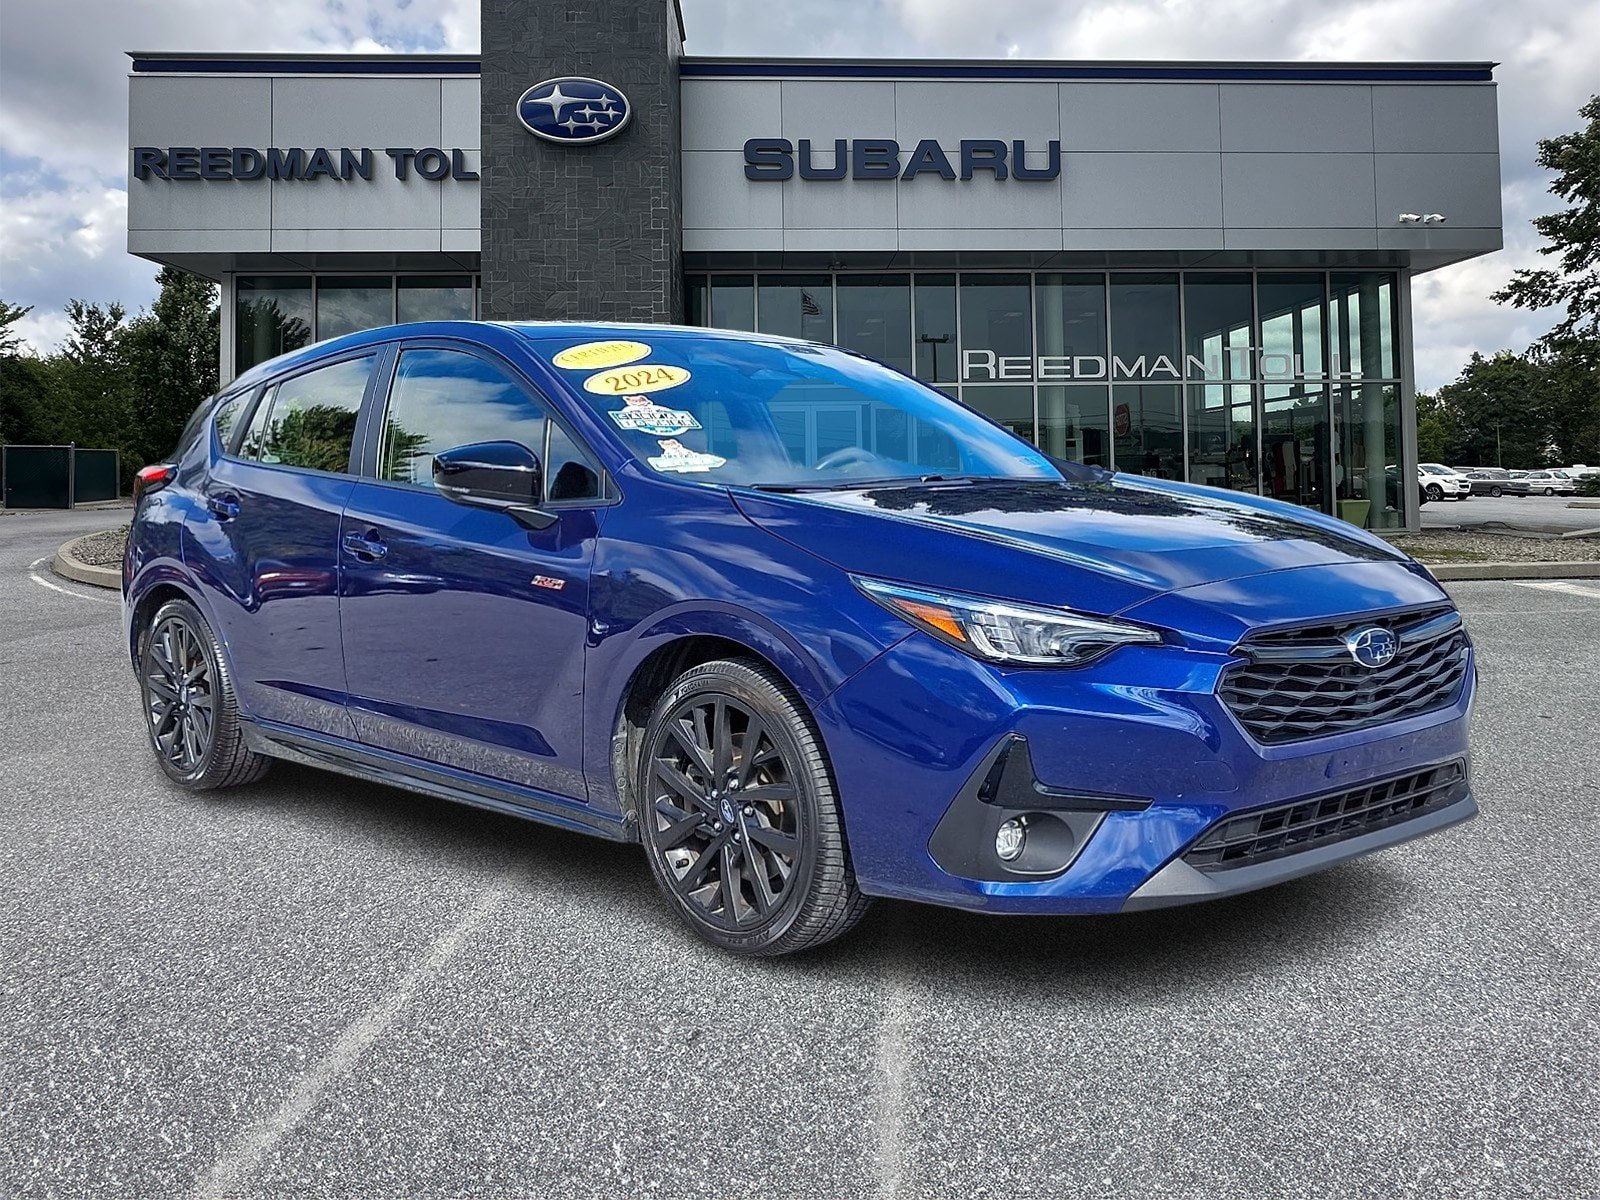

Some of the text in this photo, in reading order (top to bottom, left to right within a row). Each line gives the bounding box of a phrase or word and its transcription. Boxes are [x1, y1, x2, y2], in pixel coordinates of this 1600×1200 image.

[133, 147, 373, 181] REEDMAN
[744, 138, 1062, 181] SUBARU
[605, 368, 675, 391] 2024
